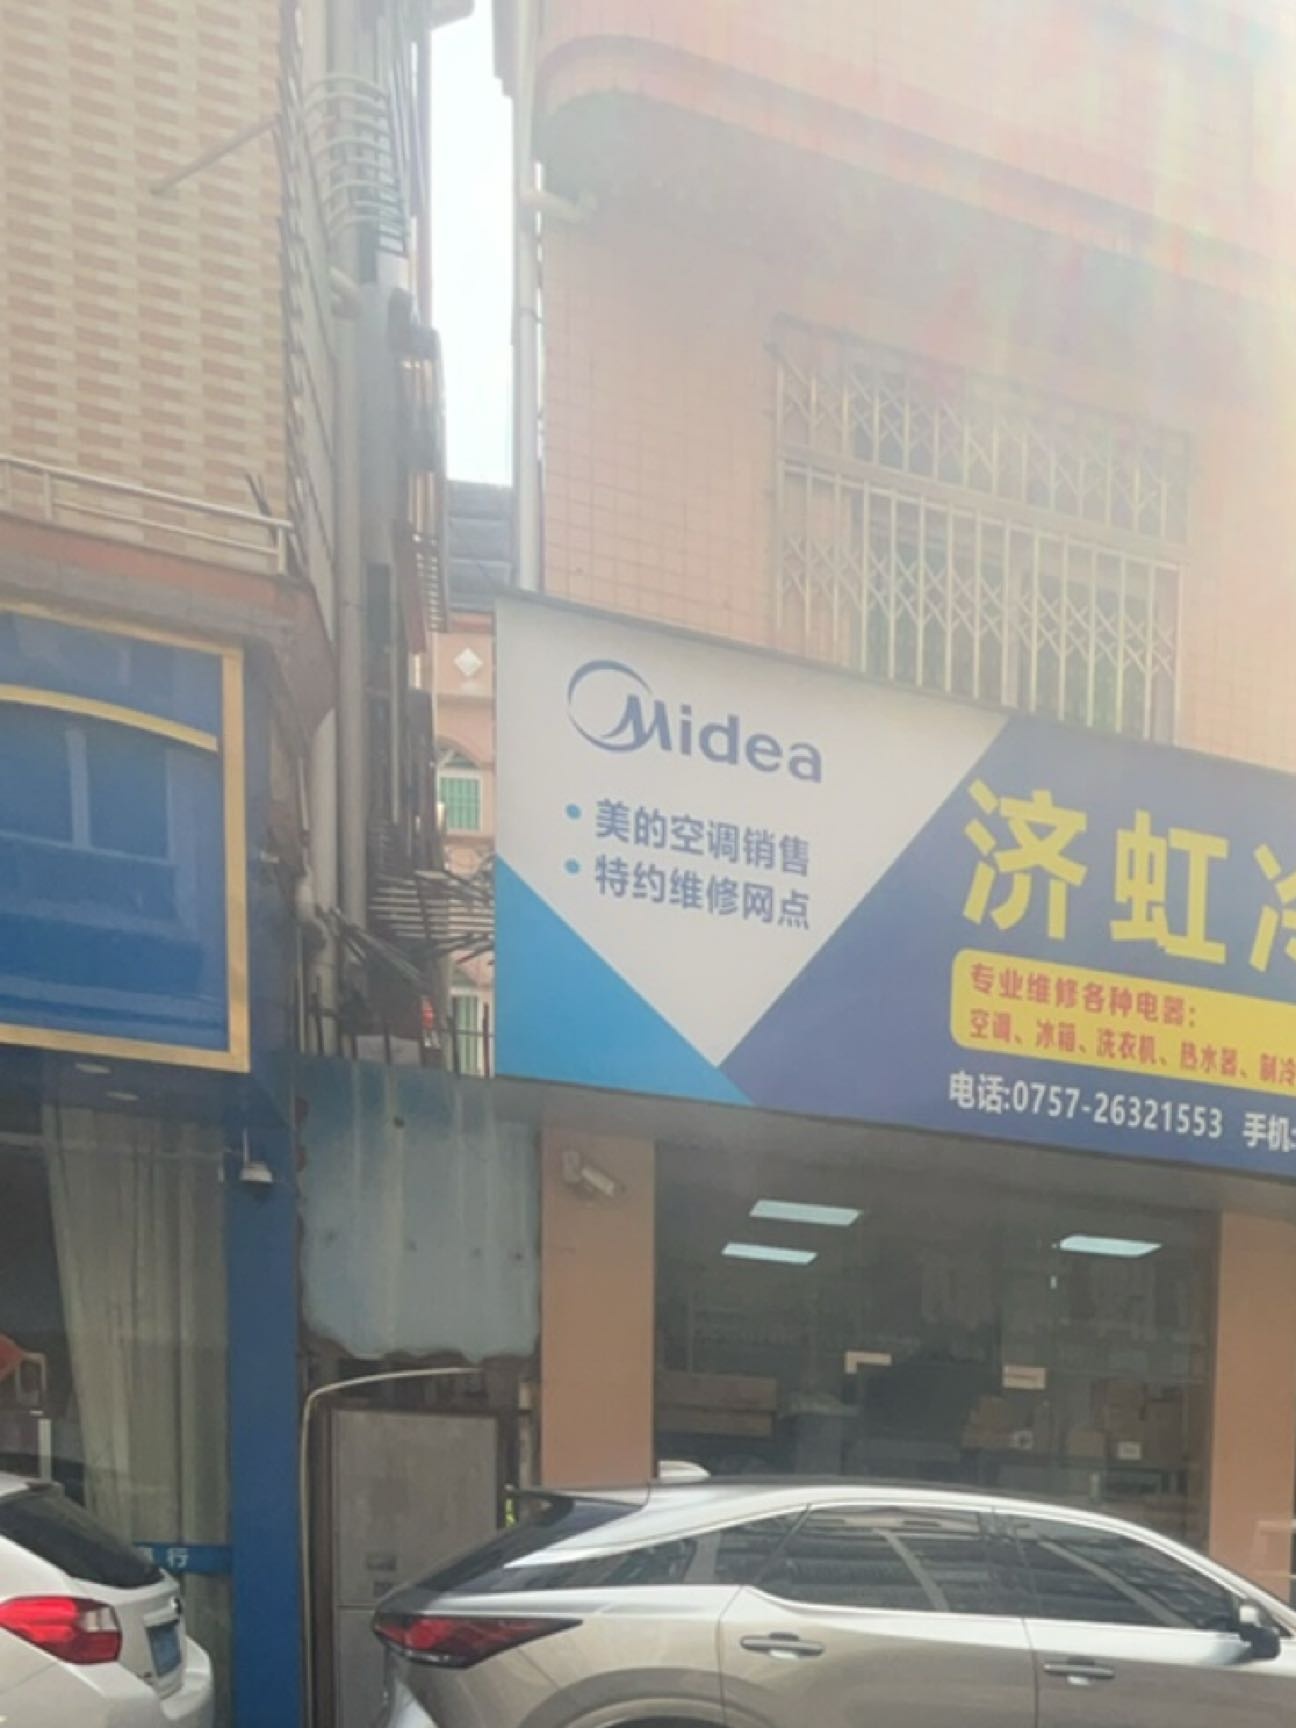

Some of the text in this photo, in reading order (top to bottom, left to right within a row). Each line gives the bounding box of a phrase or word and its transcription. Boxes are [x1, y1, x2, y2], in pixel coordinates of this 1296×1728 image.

[590, 688, 823, 784] Midea
[595, 798, 811, 877] 美的空调销售
[595, 854, 811, 931] 特约维修网点
[969, 962, 1197, 1028] 专业维修各种电器:
[948, 1069, 1225, 1139] 电话:0757-26321553
